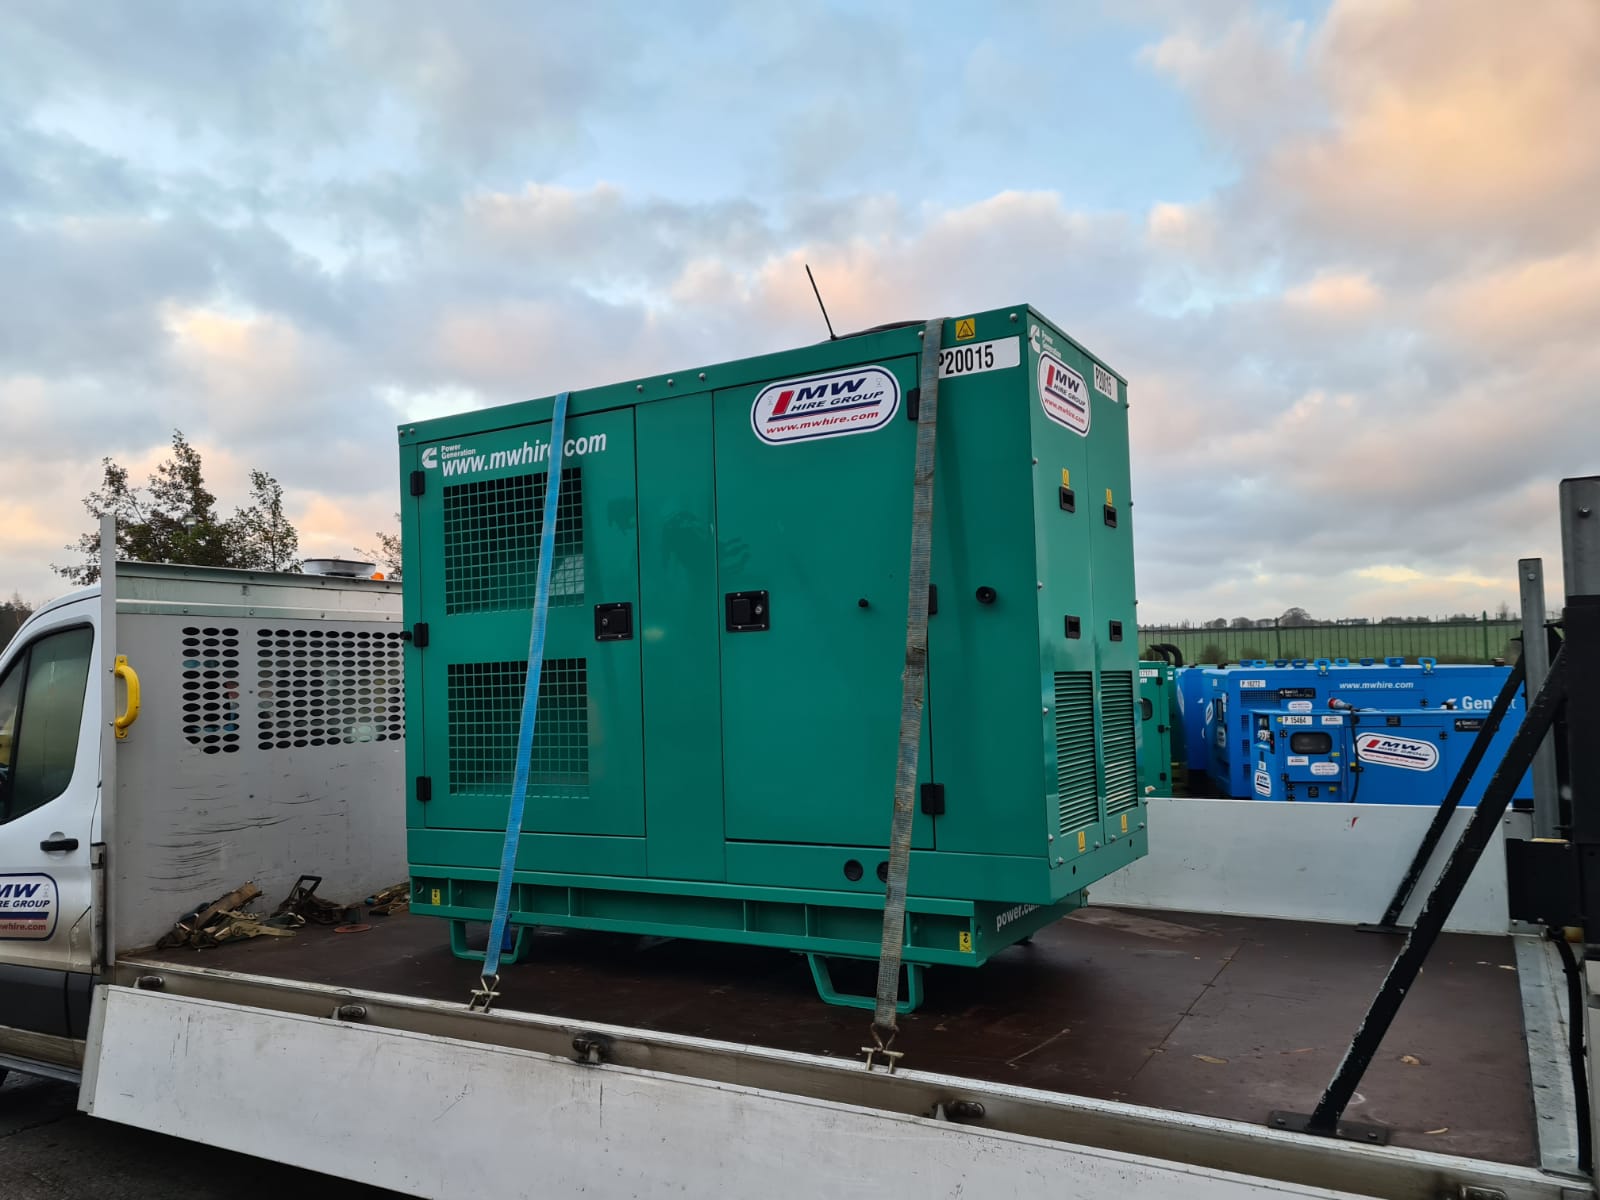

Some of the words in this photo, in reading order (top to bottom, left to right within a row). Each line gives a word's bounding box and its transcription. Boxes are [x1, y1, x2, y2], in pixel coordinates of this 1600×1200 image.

[1055, 369, 1080, 393] MW
[796, 377, 867, 402] MW
[1053, 382, 1068, 397] HIRE
[1067, 391, 1086, 407] GROUP
[791, 400, 826, 412] HIRE
[830, 390, 885, 406] GROUP
[766, 411, 879, 434] www.mwhire.com
[441, 444, 461, 453] Power
[441, 448, 476, 460] Generation
[442, 433, 607, 477] www.mwhircom
[1339, 681, 1414, 689] www.mwhire.com
[1462, 695, 1517, 710] Gent
[1382, 741, 1421, 751] MW
[12, 900, 50, 908] GROUP
[0, 922, 47, 930] whire.com
